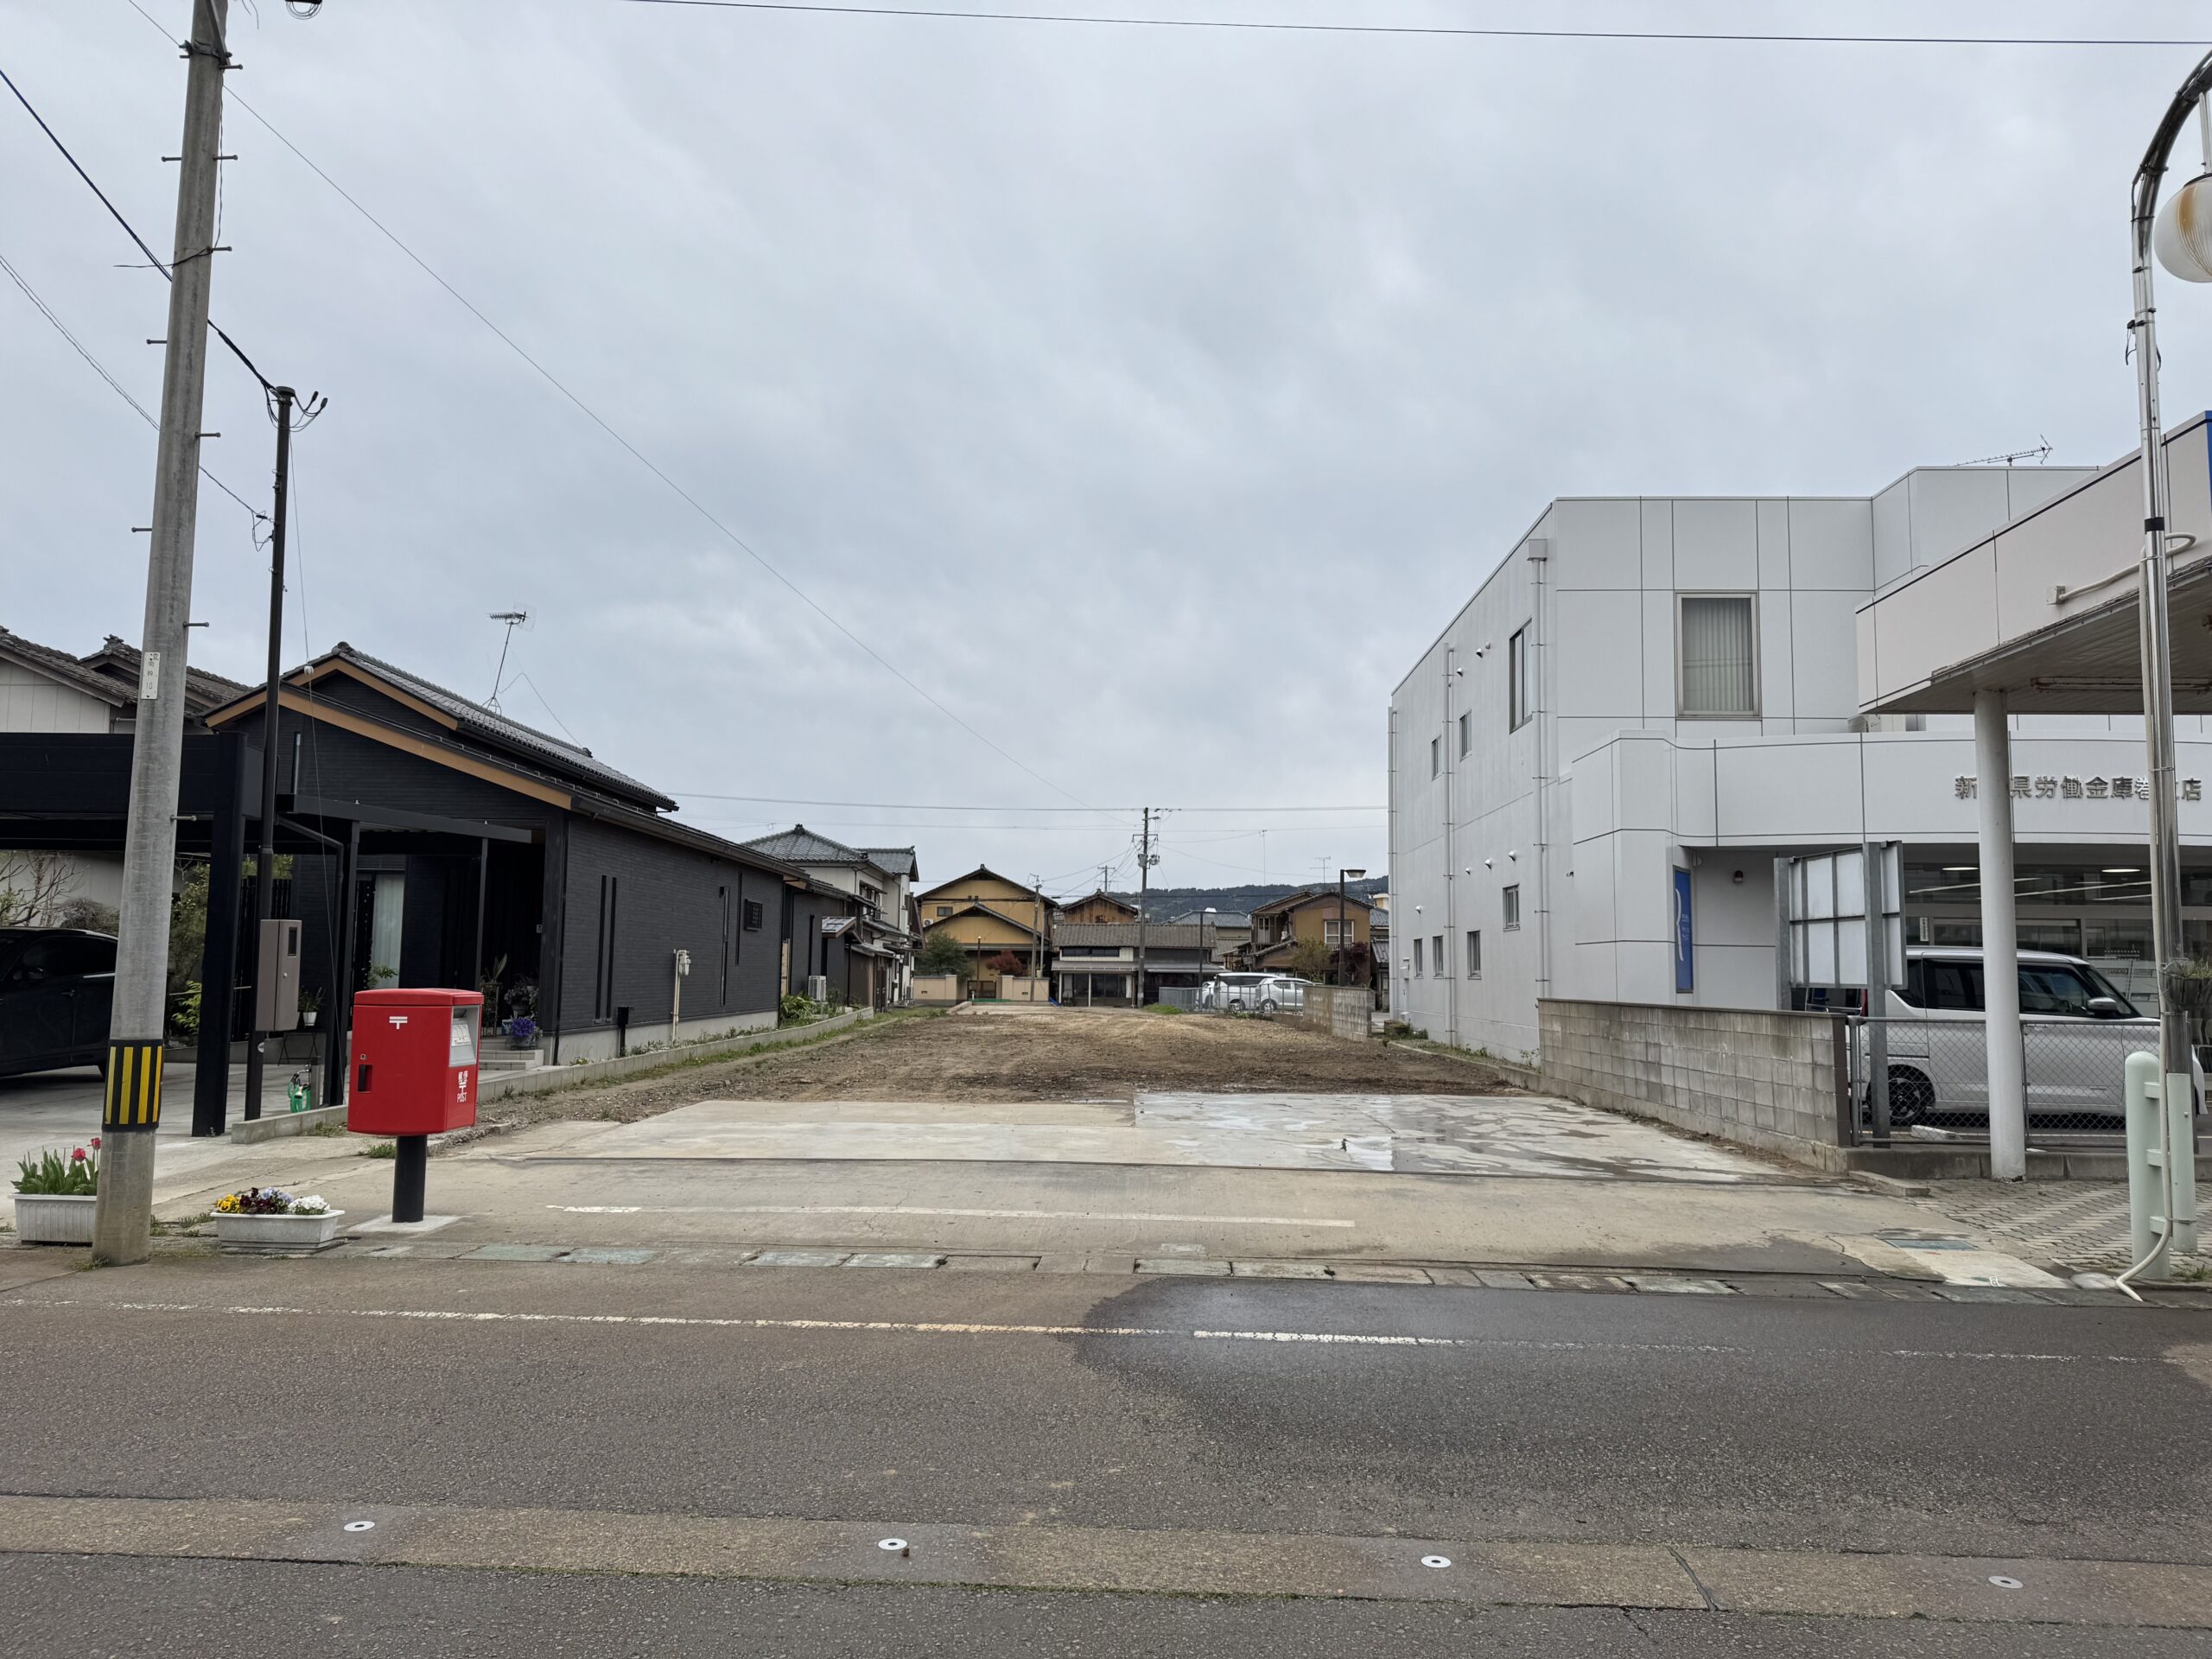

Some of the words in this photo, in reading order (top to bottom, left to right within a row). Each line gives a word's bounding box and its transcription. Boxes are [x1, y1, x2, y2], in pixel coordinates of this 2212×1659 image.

[1955, 775, 2202, 801] 新県労働金庫巻店
[456, 1092, 467, 1103] POST
